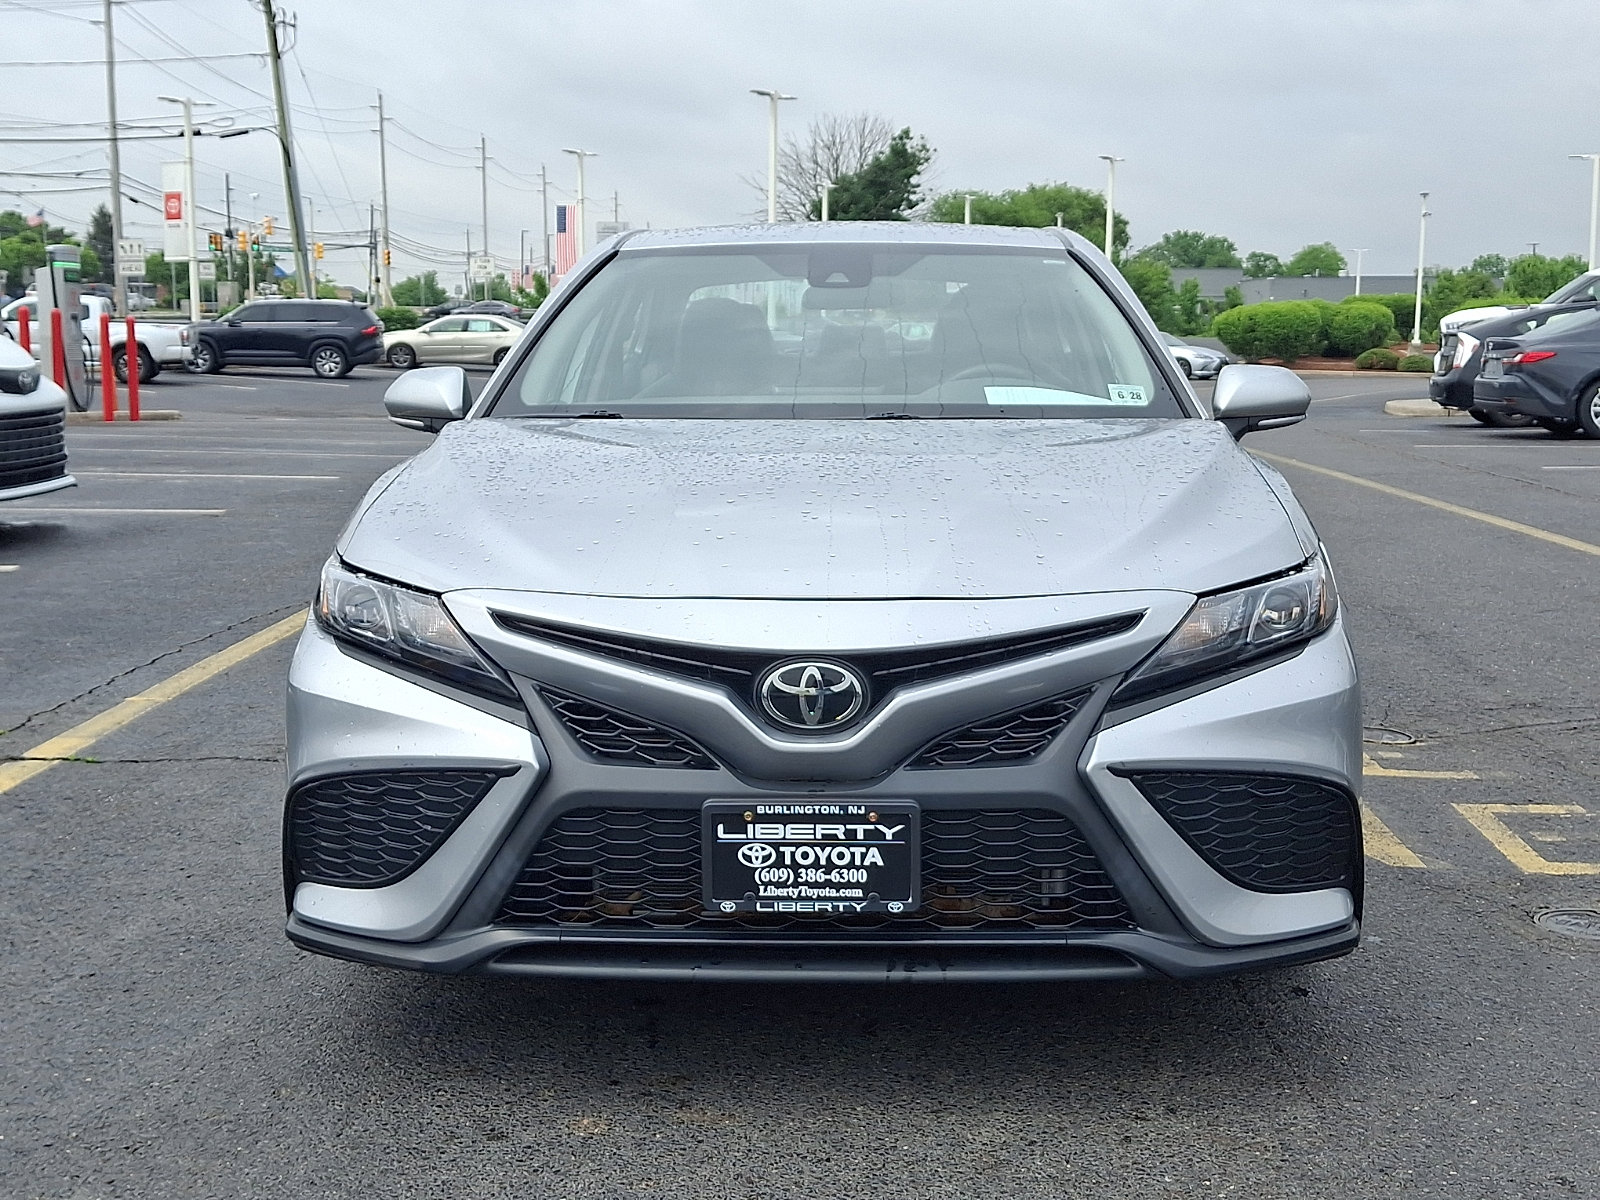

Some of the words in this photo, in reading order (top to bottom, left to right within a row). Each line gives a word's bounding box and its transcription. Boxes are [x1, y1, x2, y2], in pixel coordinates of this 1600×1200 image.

[1117, 390, 1125, 399] 6
[1129, 391, 1142, 400] 28
[848, 805, 866, 815] NJ
[717, 823, 906, 840] LIBERTY
[779, 846, 885, 867] TOYOTA
[754, 868, 795, 885] (609)
[797, 868, 868, 883] 386-6300
[758, 885, 863, 898] LibertyToyota.com
[756, 901, 868, 912] LIBERTY
